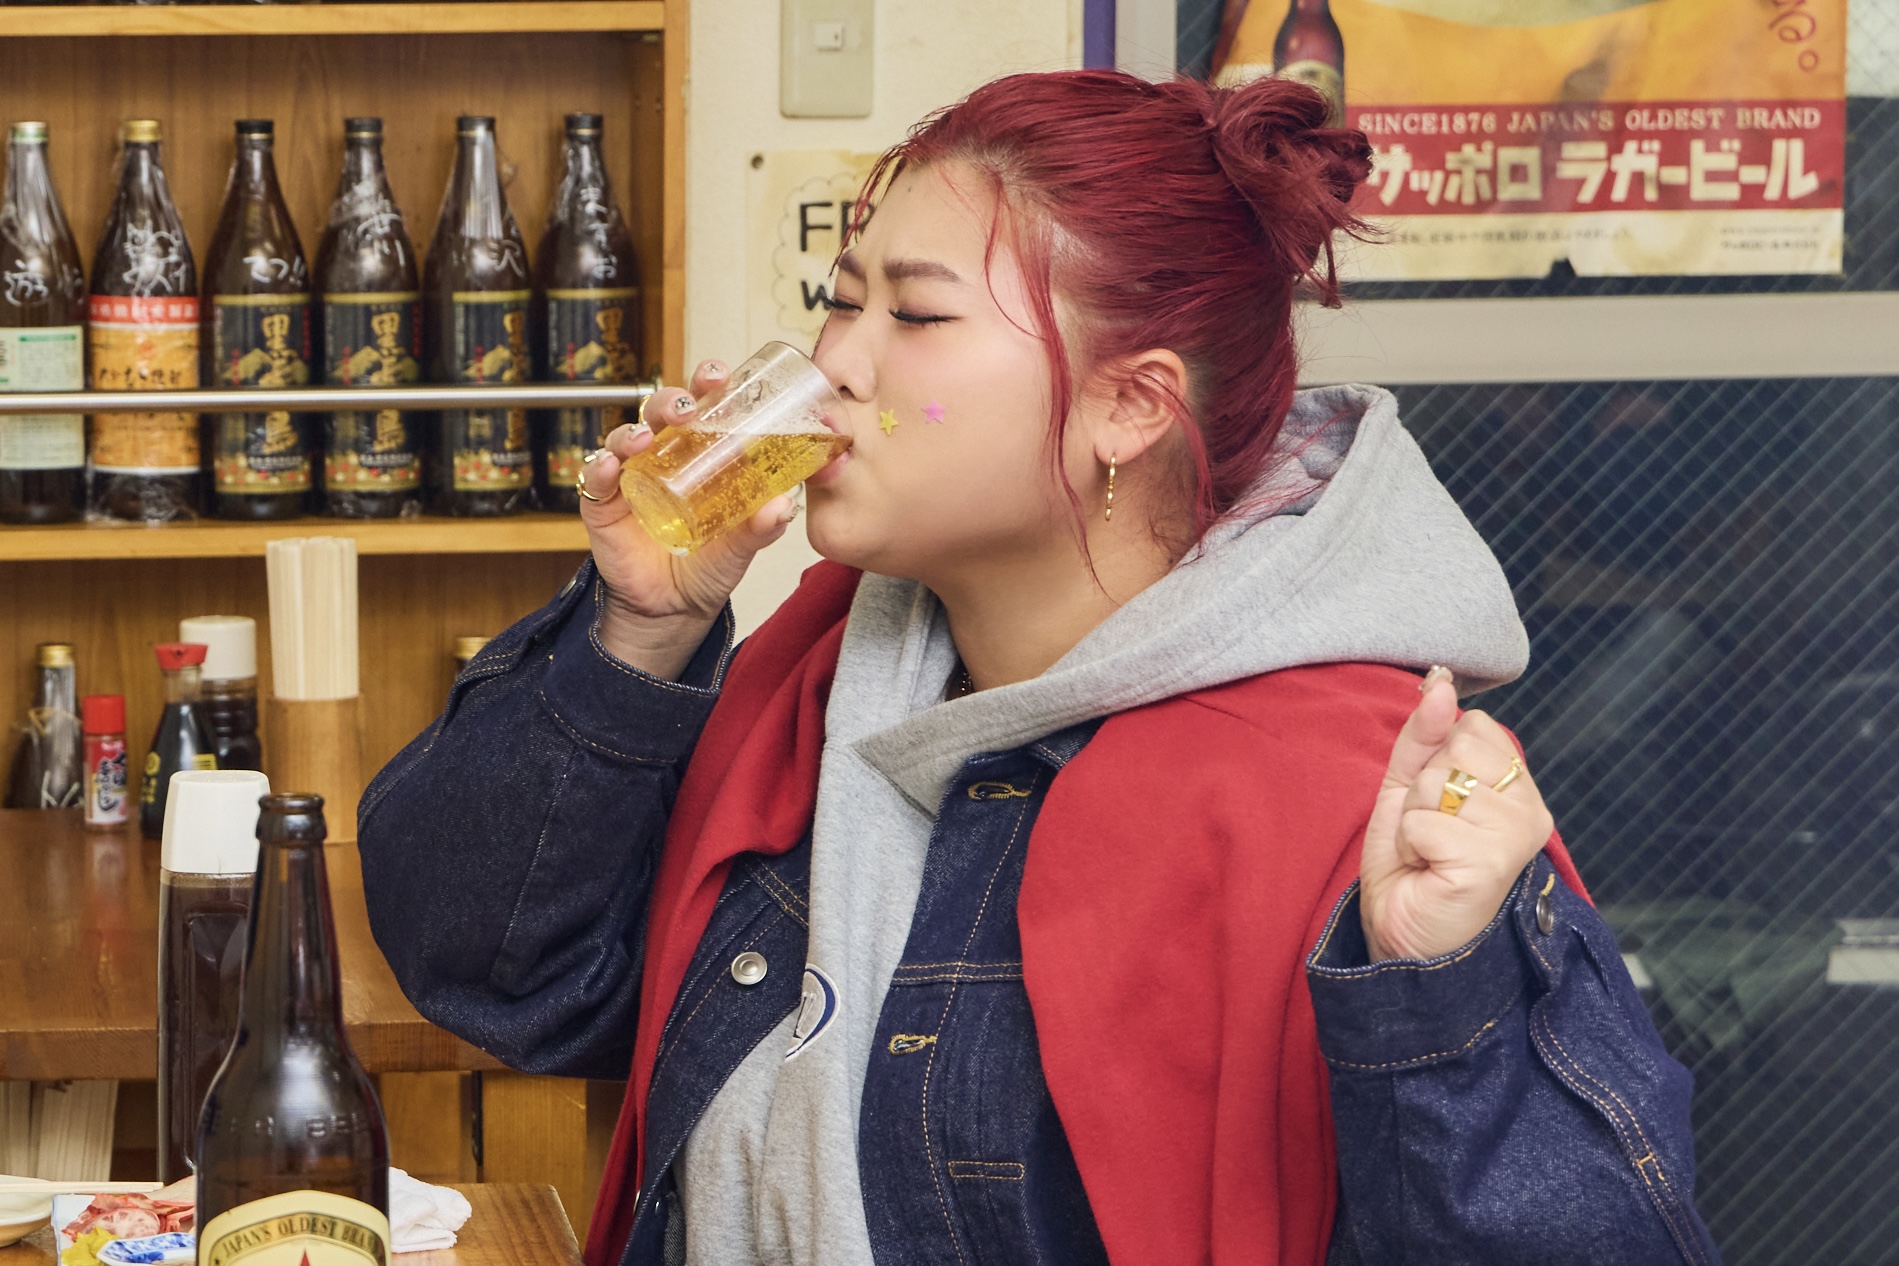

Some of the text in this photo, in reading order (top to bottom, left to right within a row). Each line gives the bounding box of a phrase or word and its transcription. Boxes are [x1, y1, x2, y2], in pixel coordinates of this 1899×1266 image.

[1357, 106, 1822, 135] SINCE1876 JAPAN'S OLDEST BRAND
[1366, 138, 1820, 206] サッポロ ラガービール
[223, 1225, 273, 1258] JAPAN'S
[277, 1216, 337, 1237] OLDEST
